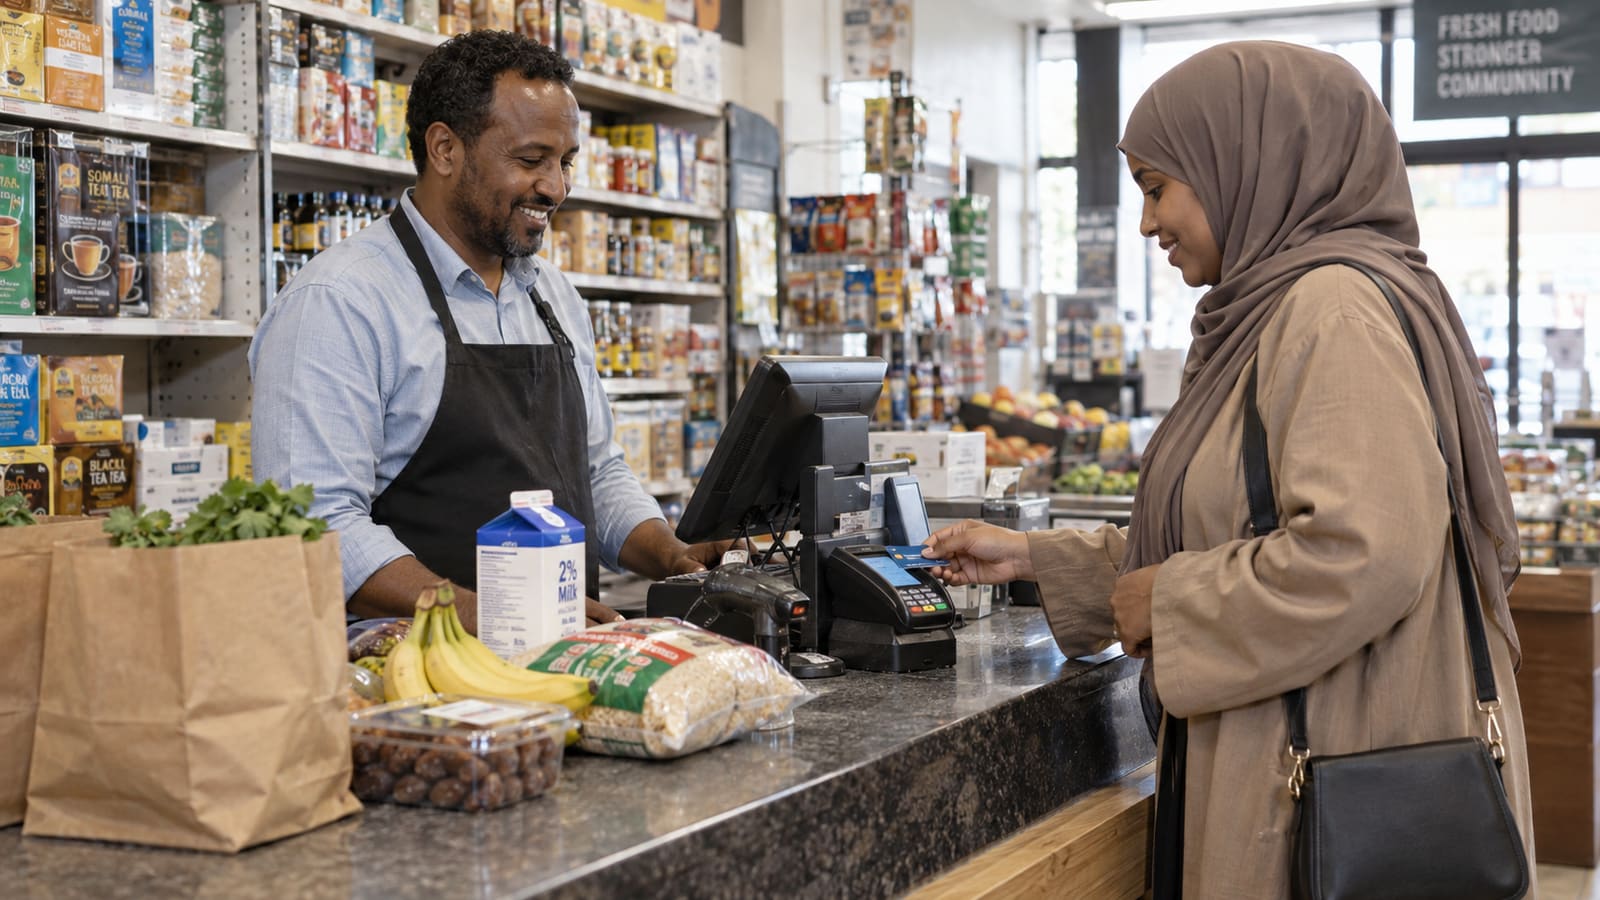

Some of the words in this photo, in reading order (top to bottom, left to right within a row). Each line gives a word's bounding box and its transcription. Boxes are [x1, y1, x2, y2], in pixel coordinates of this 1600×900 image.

[1438, 13, 1501, 39] FRESH
[1507, 8, 1559, 35] FOOD
[1437, 39, 1543, 69] STRONGER
[88, 169, 129, 185] SOMALI
[111, 185, 130, 200] TEA
[89, 472, 108, 486] TEA
[109, 470, 127, 484] TEA
[558, 560, 577, 583] 2%
[558, 584, 577, 603] Milk
